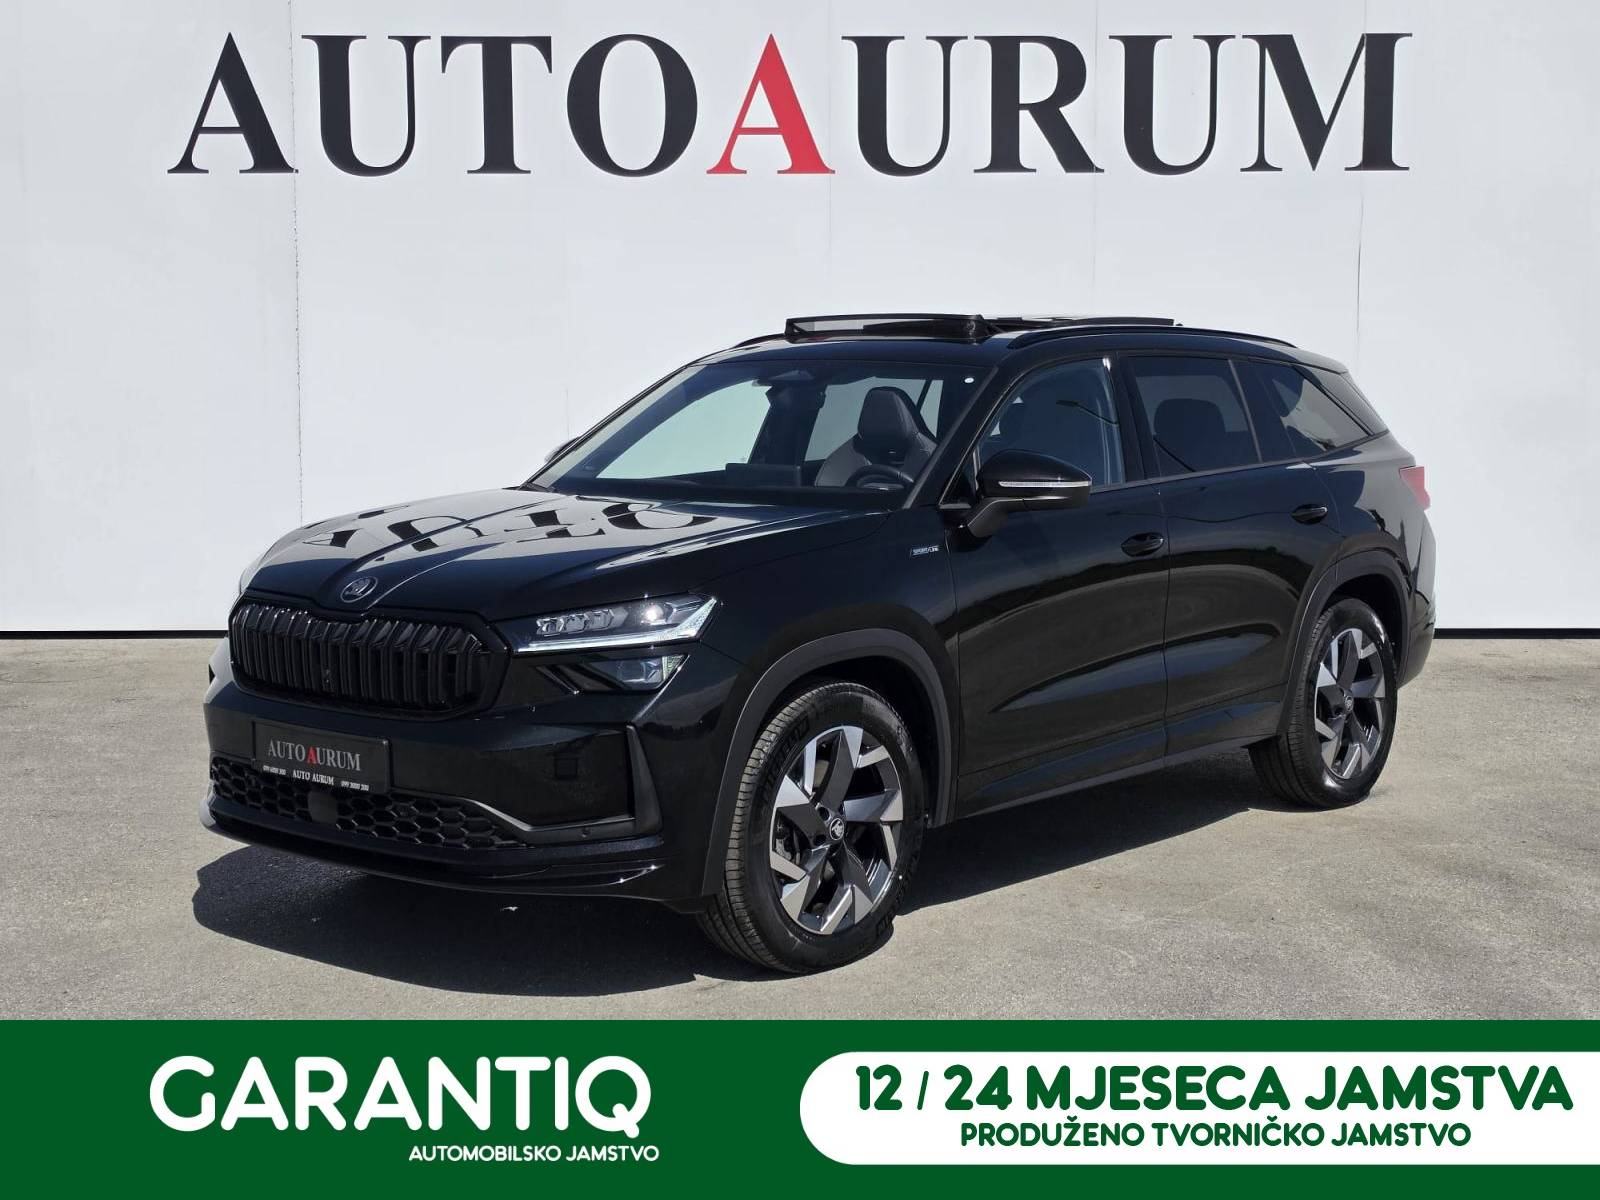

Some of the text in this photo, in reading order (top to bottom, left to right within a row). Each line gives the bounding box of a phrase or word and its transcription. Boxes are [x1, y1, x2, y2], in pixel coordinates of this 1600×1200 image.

[168, 33, 1412, 177] AUTOAURUM
[293, 769, 311, 780] AUTO
[312, 772, 335, 786] AURUM
